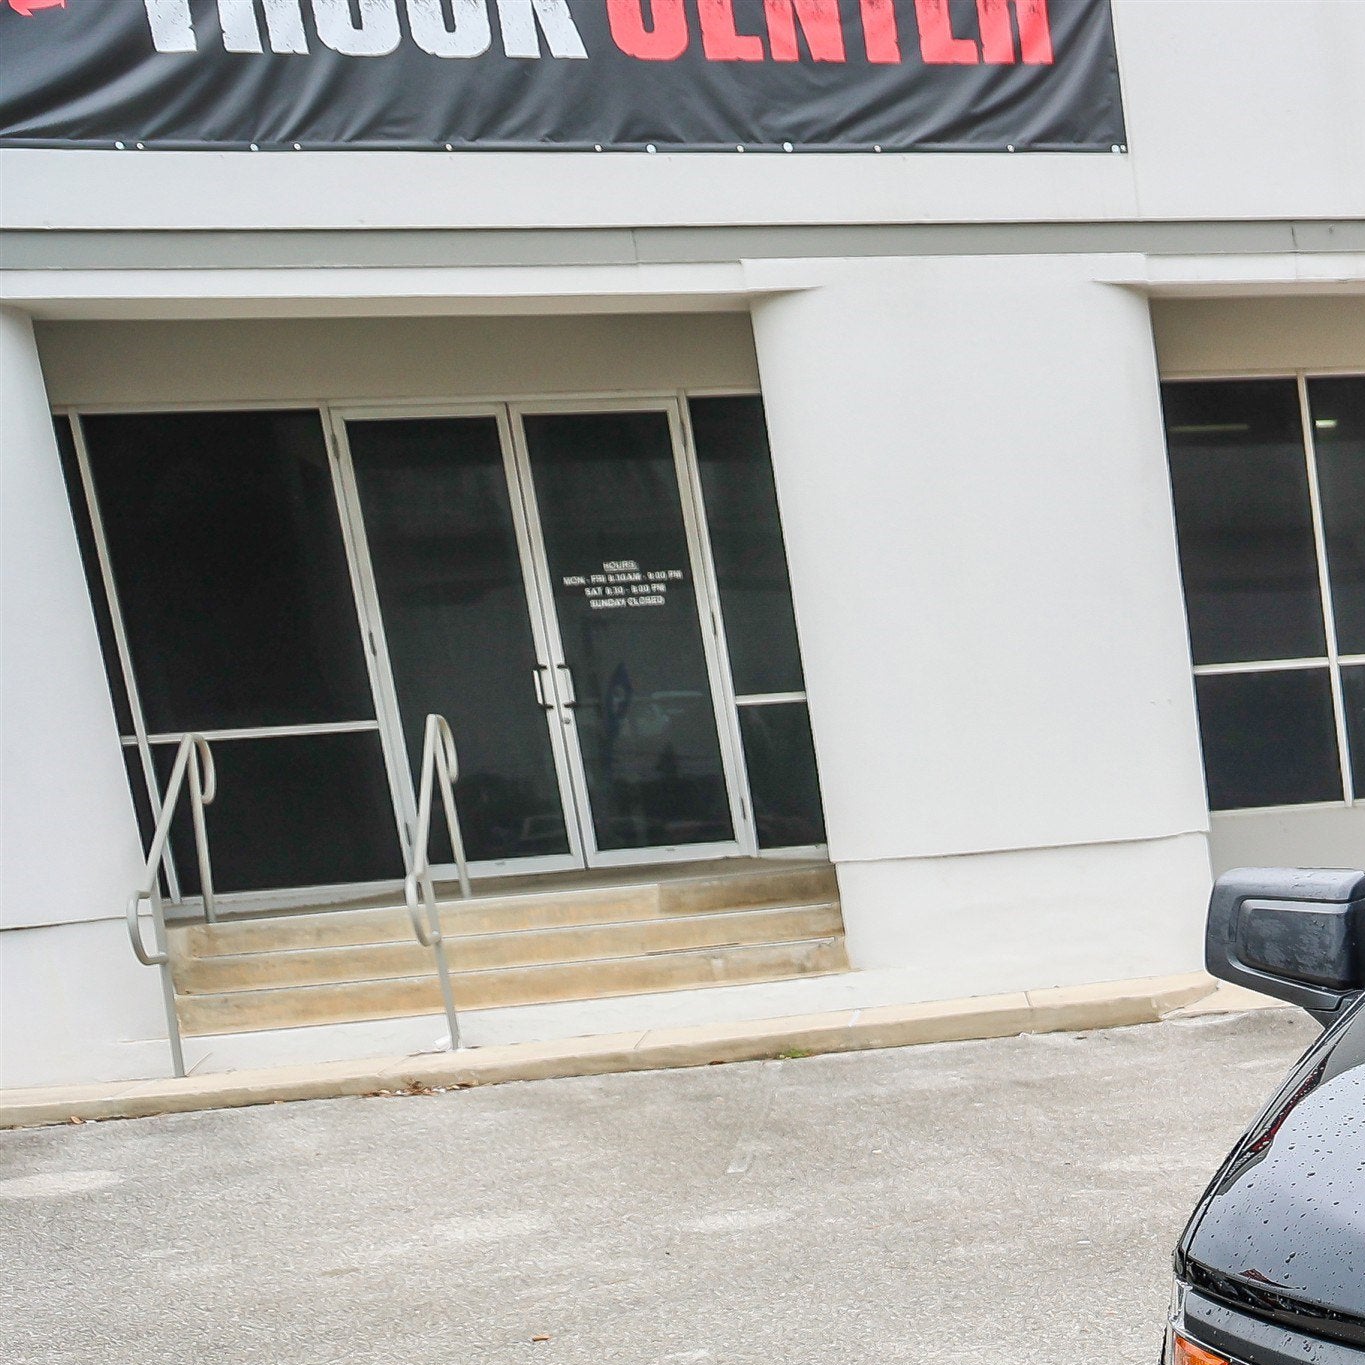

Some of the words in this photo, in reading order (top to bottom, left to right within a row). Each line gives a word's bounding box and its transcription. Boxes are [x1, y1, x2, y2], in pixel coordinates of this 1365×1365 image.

[584, 586, 603, 598] SAT
[589, 598, 627, 609] SUNDAY
[627, 595, 666, 607] CLOSED
